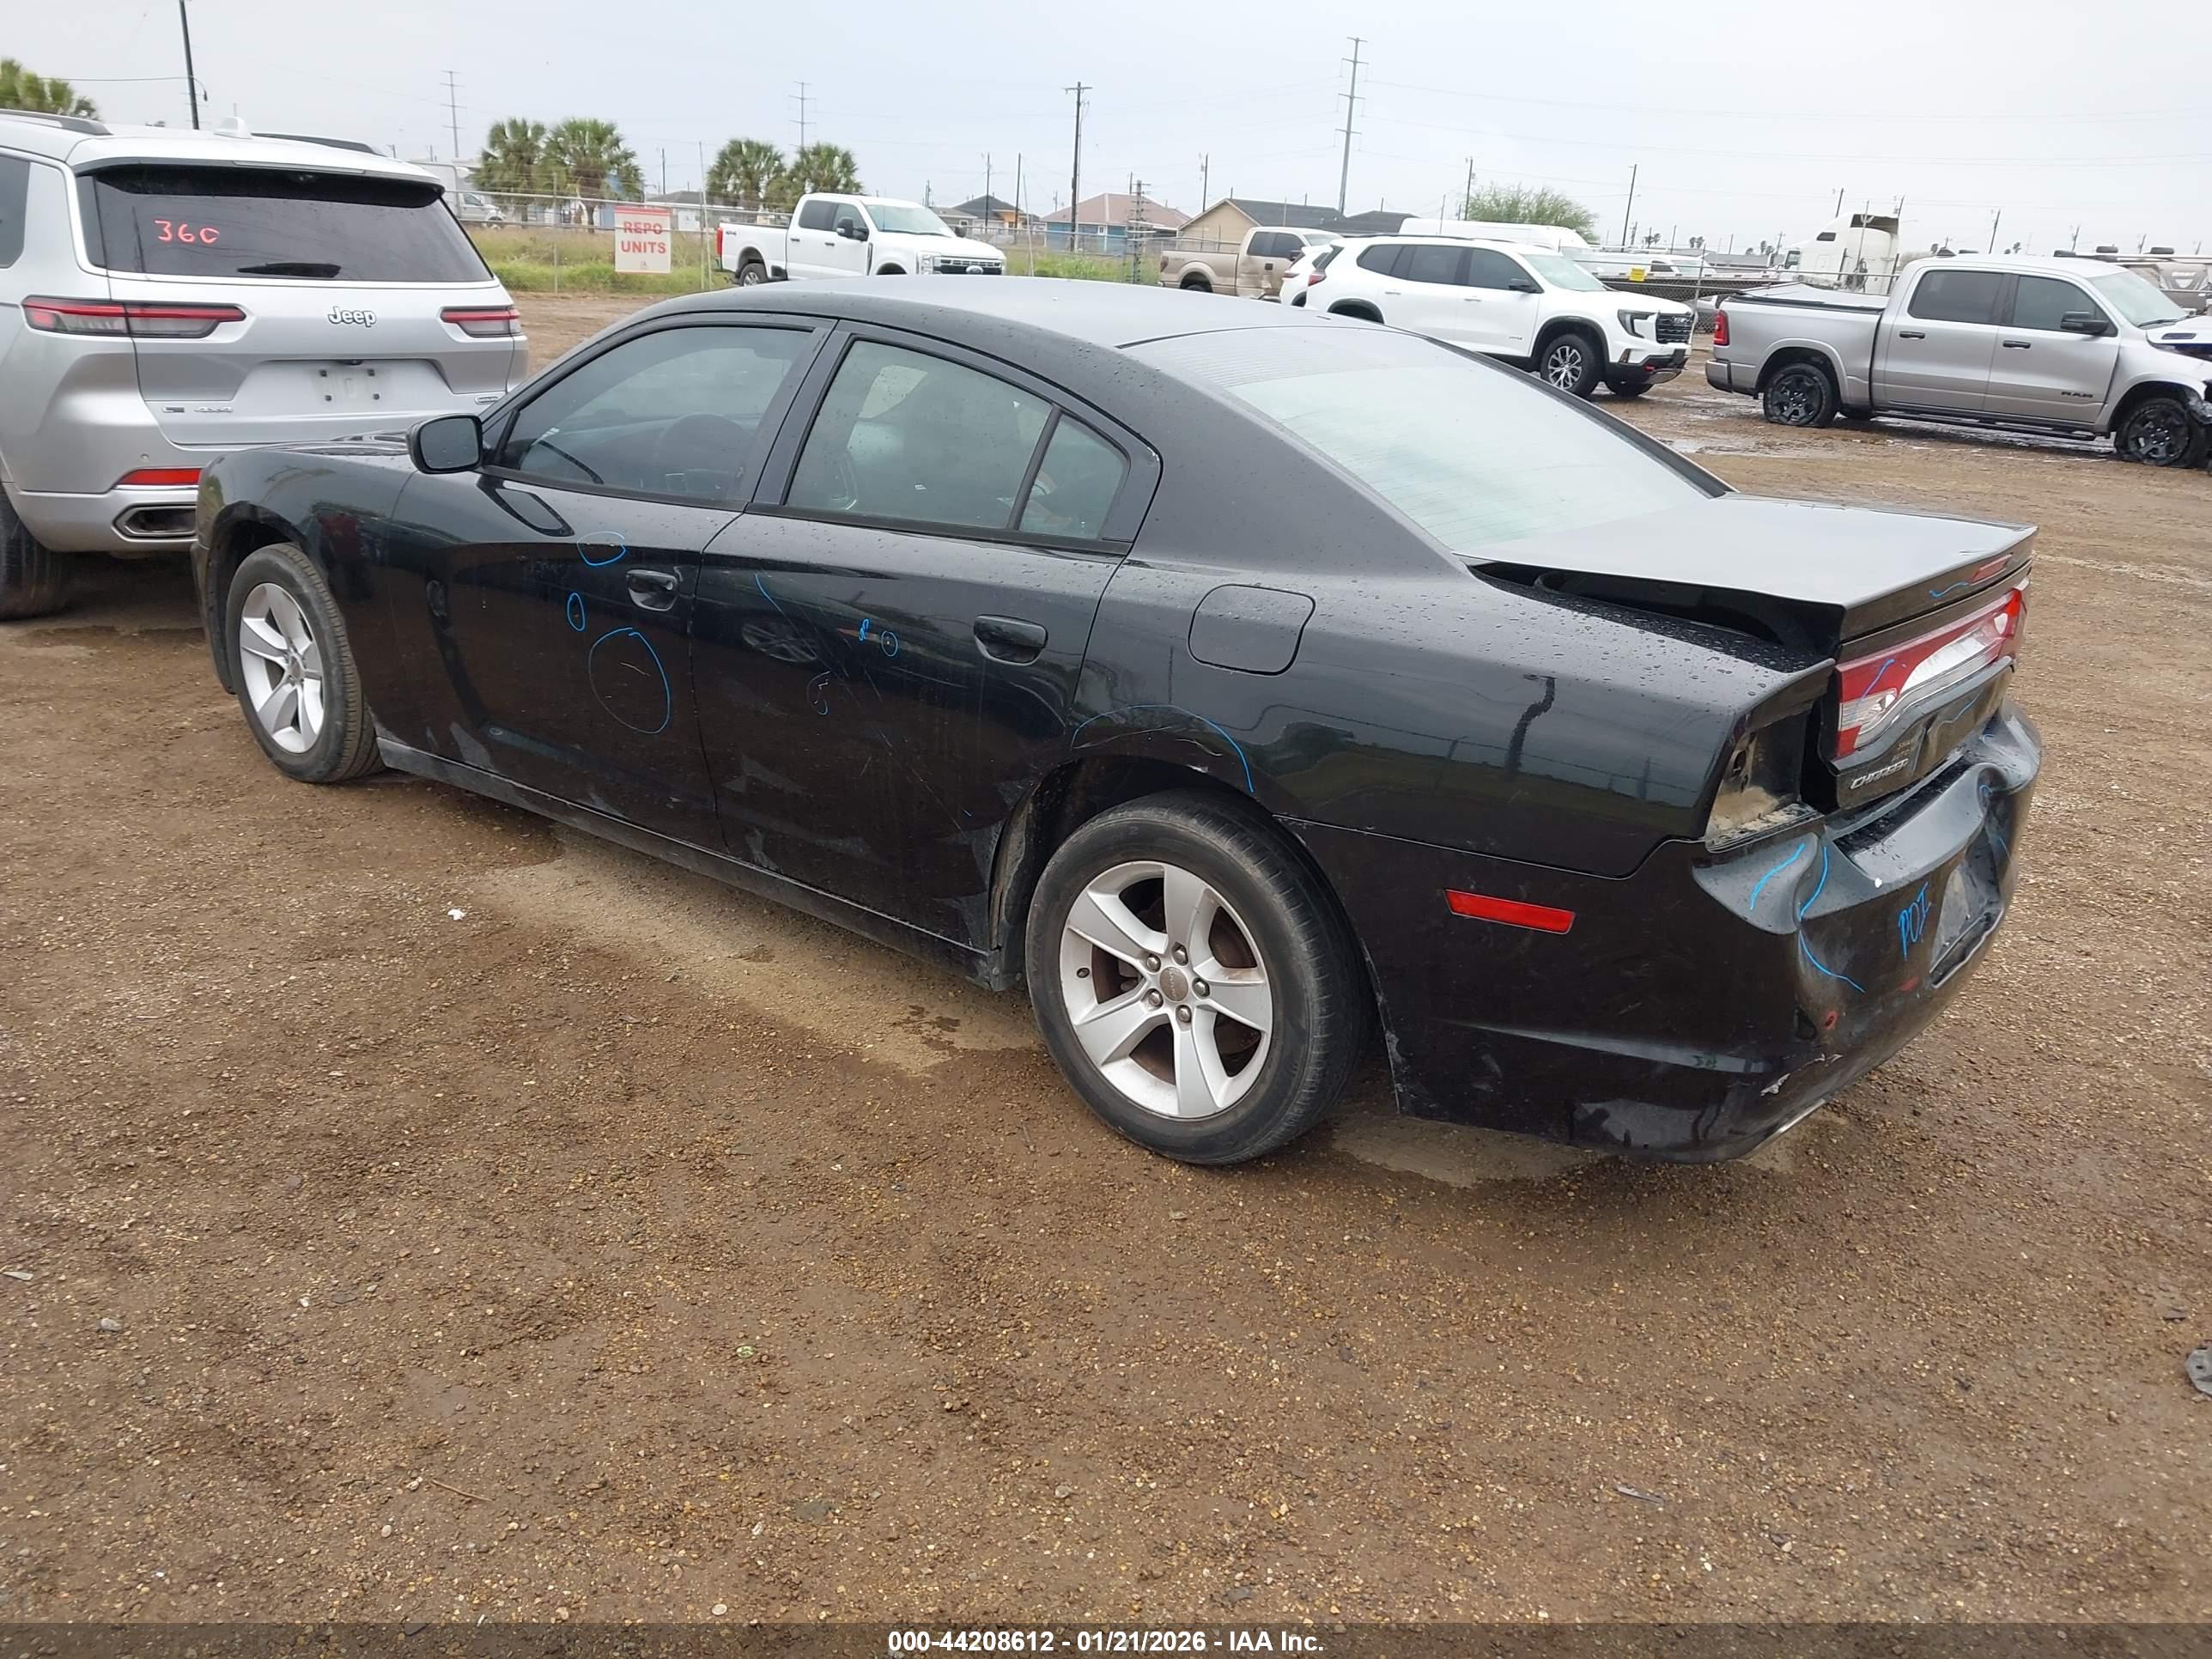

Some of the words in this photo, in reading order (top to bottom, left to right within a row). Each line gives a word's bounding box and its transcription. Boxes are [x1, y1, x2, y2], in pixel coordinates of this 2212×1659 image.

[623, 222, 663, 234] REPO
[621, 241, 666, 254] UNITS
[326, 306, 377, 328] Jeep
